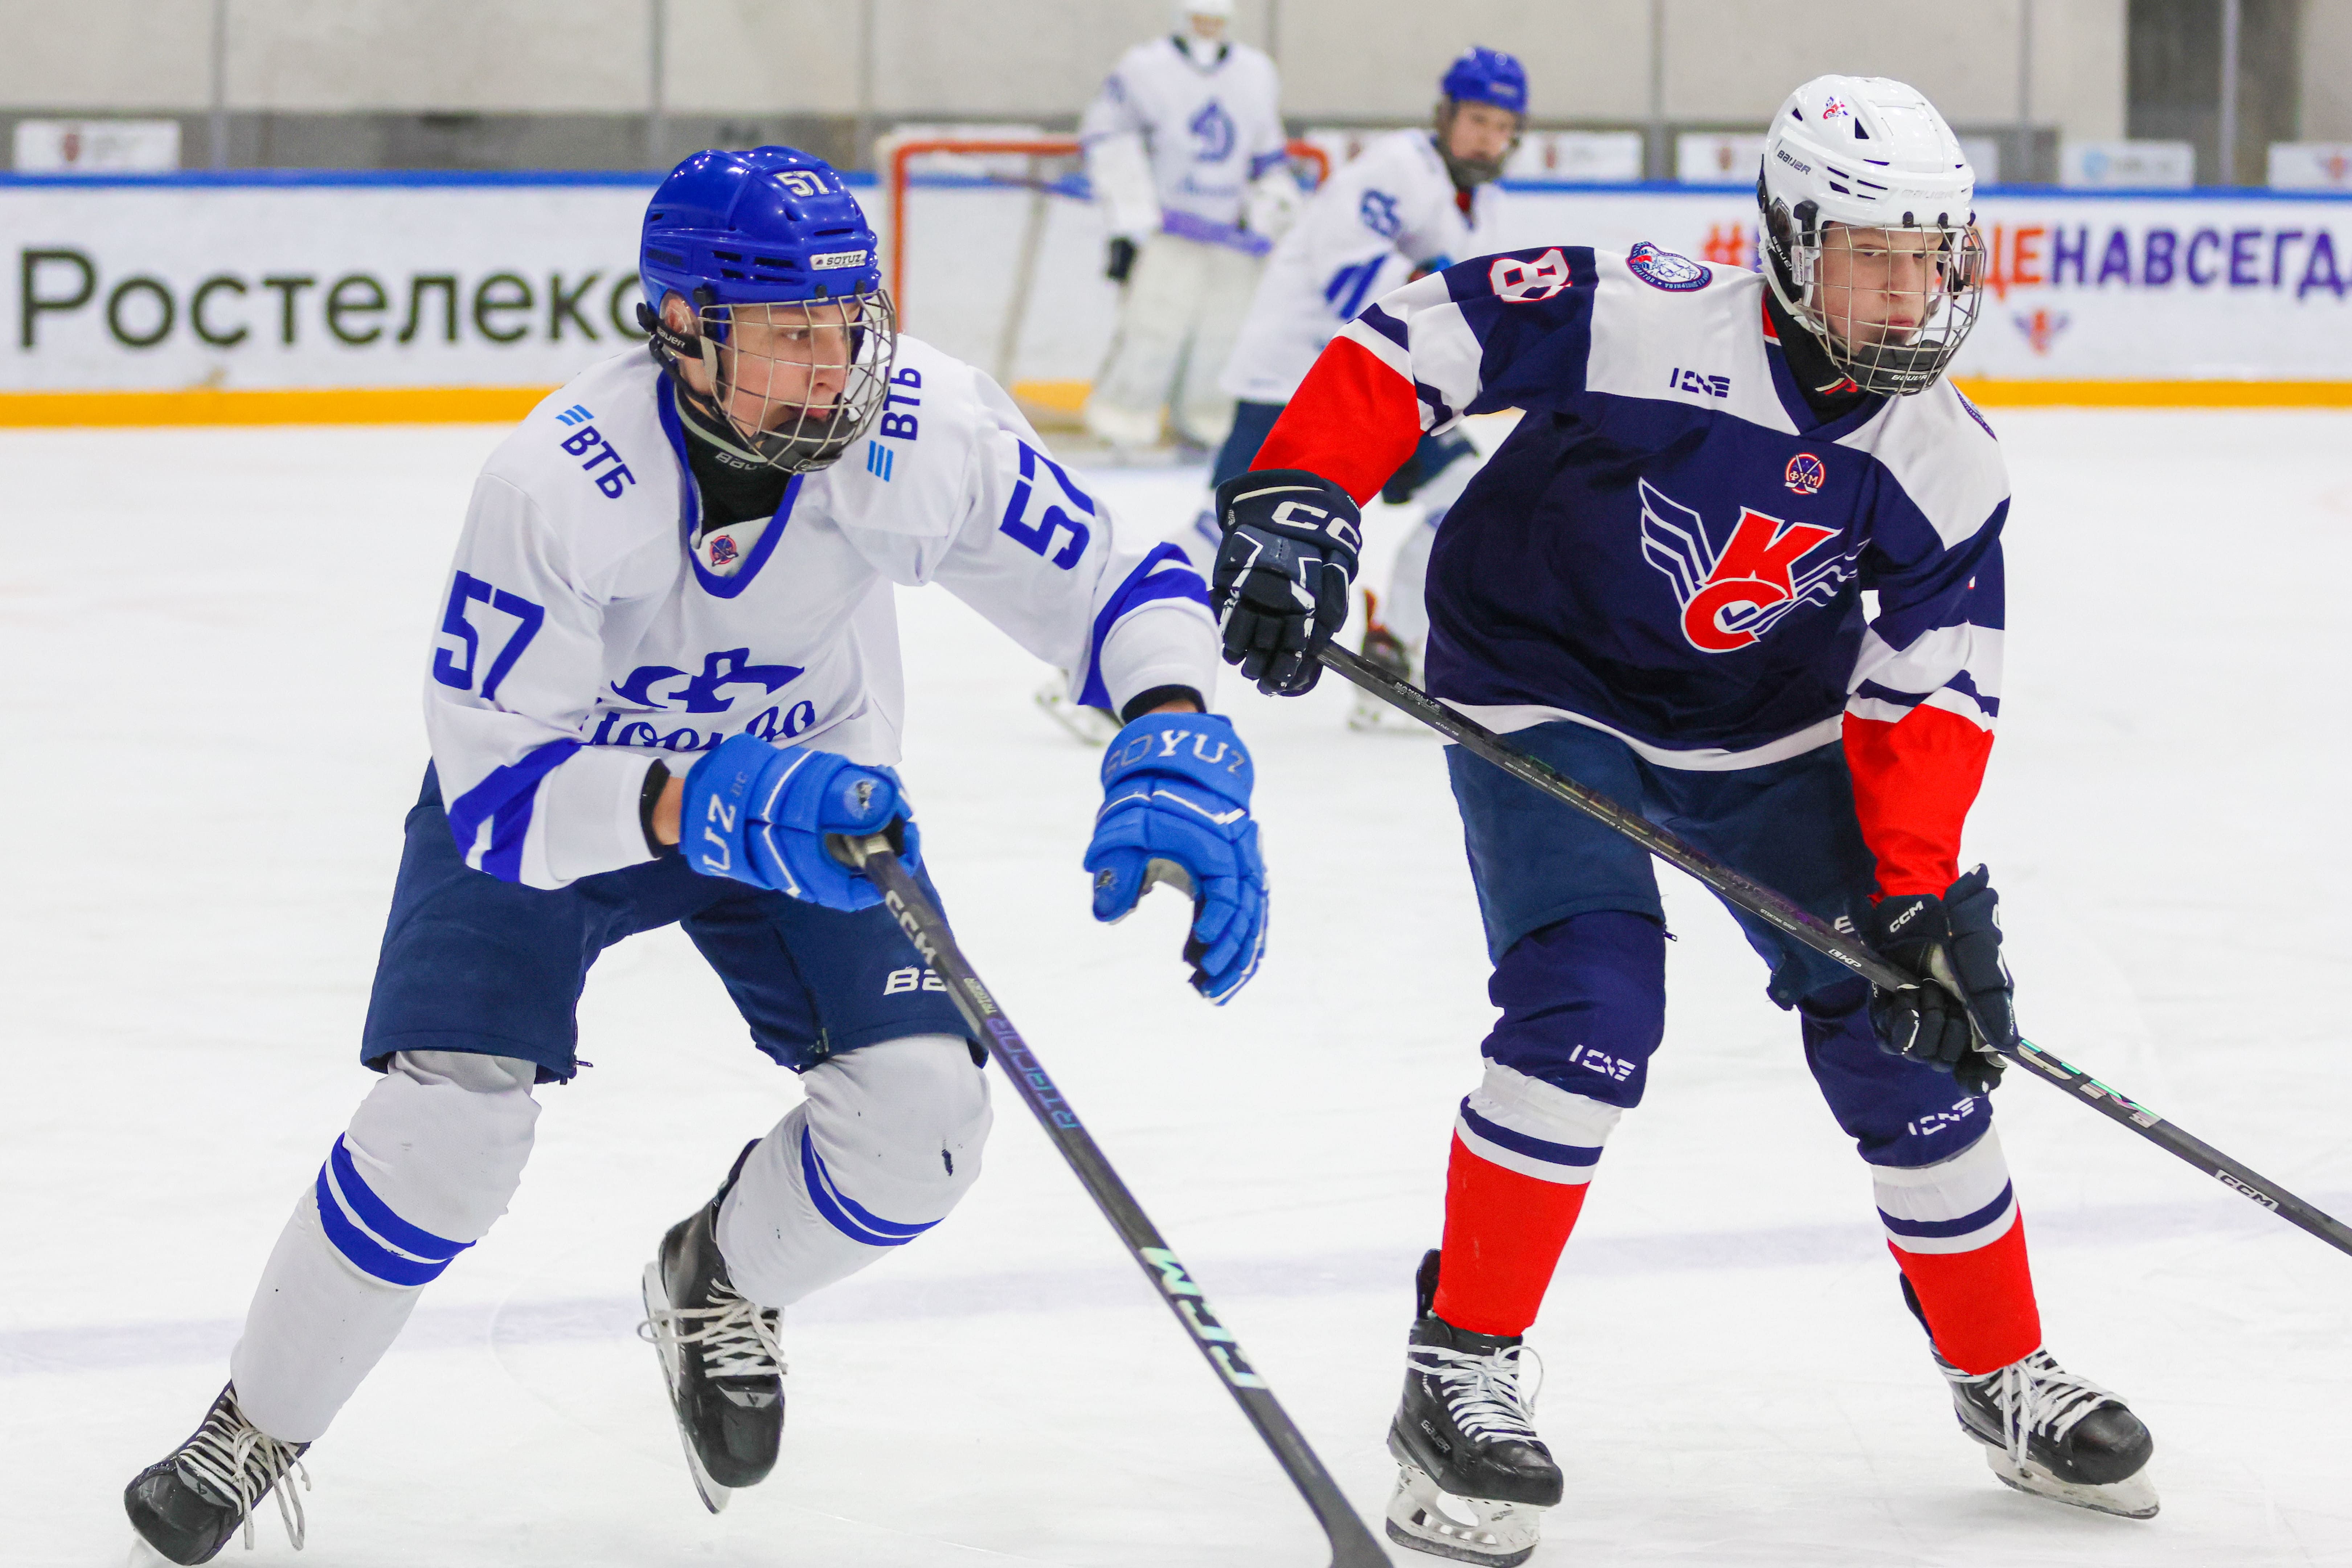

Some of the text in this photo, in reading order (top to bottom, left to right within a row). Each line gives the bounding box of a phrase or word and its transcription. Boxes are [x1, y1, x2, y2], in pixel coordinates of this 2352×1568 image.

[773, 171, 829, 197] 57
[827, 254, 861, 265] SOYUZ
[560, 425, 636, 499] ВТБ
[1790, 471, 1819, 486] ФХМ
[999, 438, 1095, 570] 57
[1271, 501, 1360, 554] CC
[433, 570, 545, 701] 57
[1889, 900, 1923, 934] CCM
[2220, 1174, 2275, 1208] CCM
[1140, 1246, 1269, 1389] CCM
